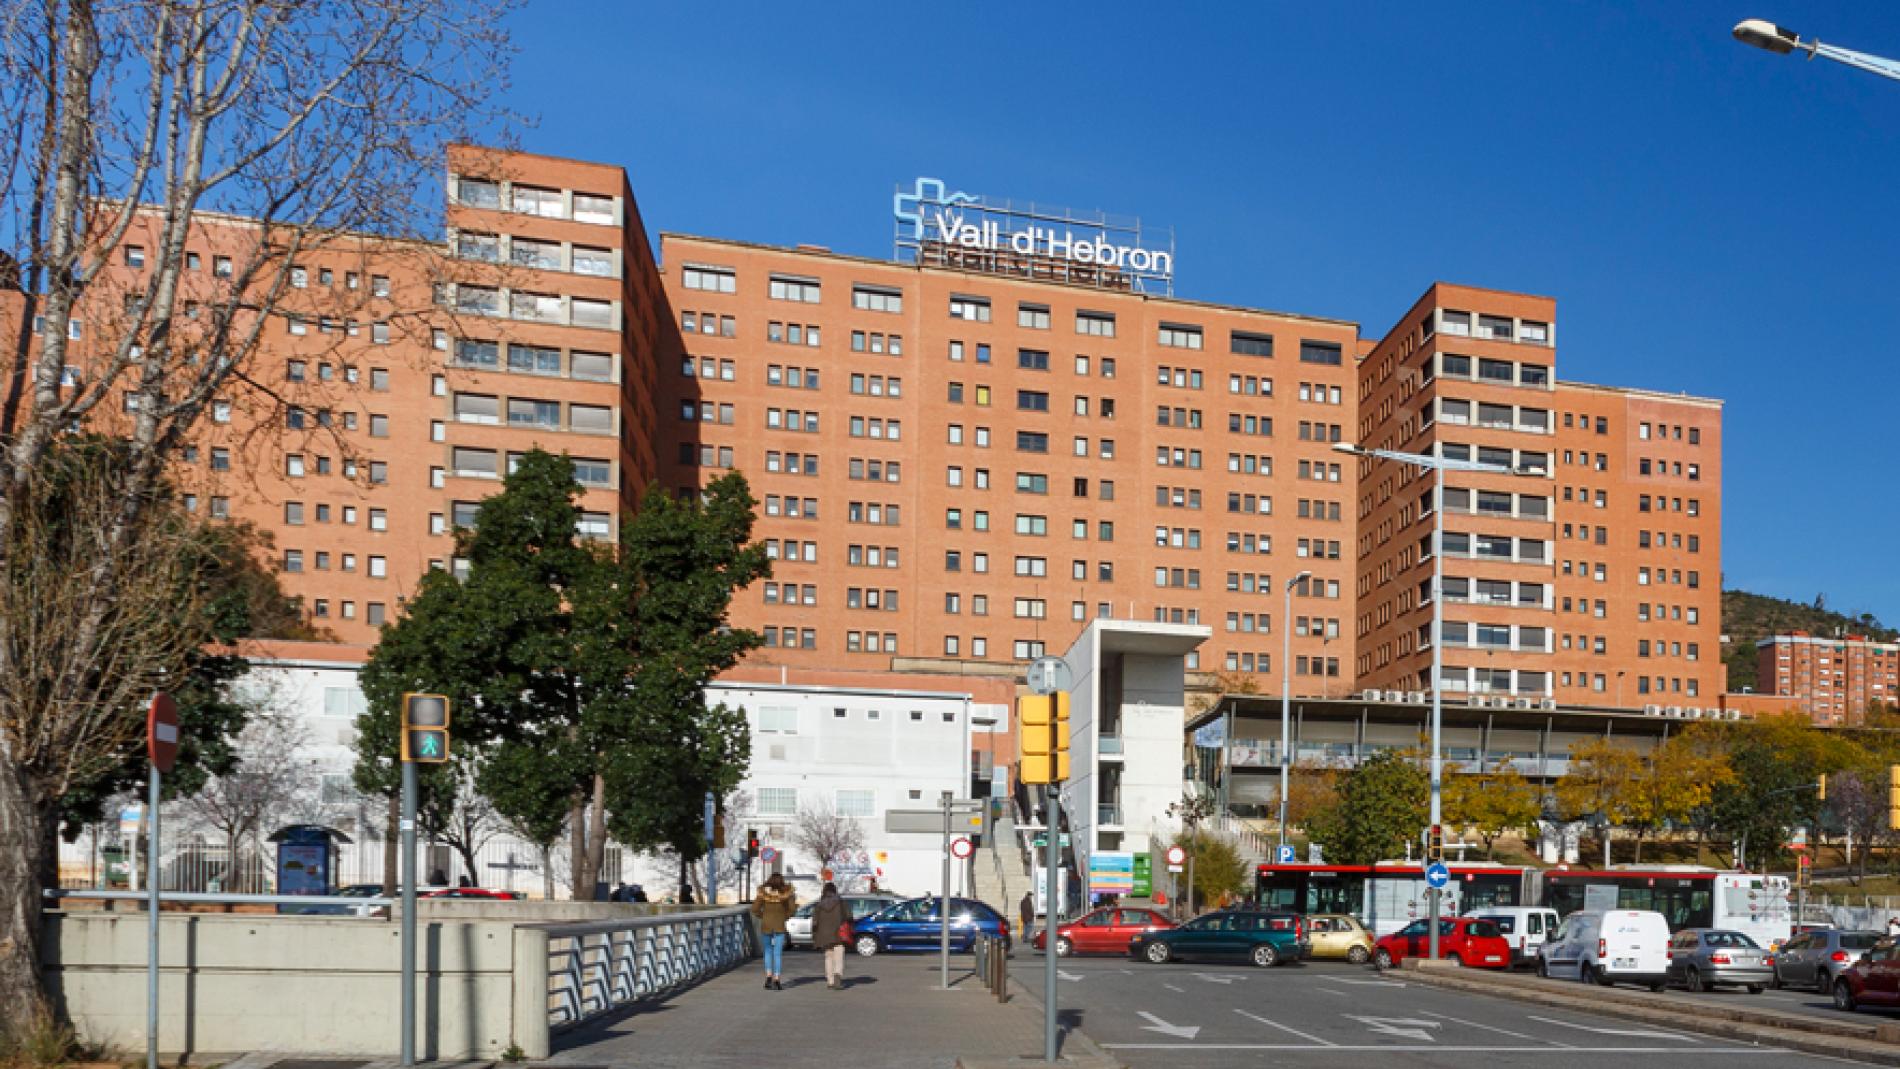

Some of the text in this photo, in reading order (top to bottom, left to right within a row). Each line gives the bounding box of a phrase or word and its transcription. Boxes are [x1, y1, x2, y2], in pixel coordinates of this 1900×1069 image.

[936, 213, 1171, 273] Vall d'Hebron
[1280, 847, 1291, 863] P
